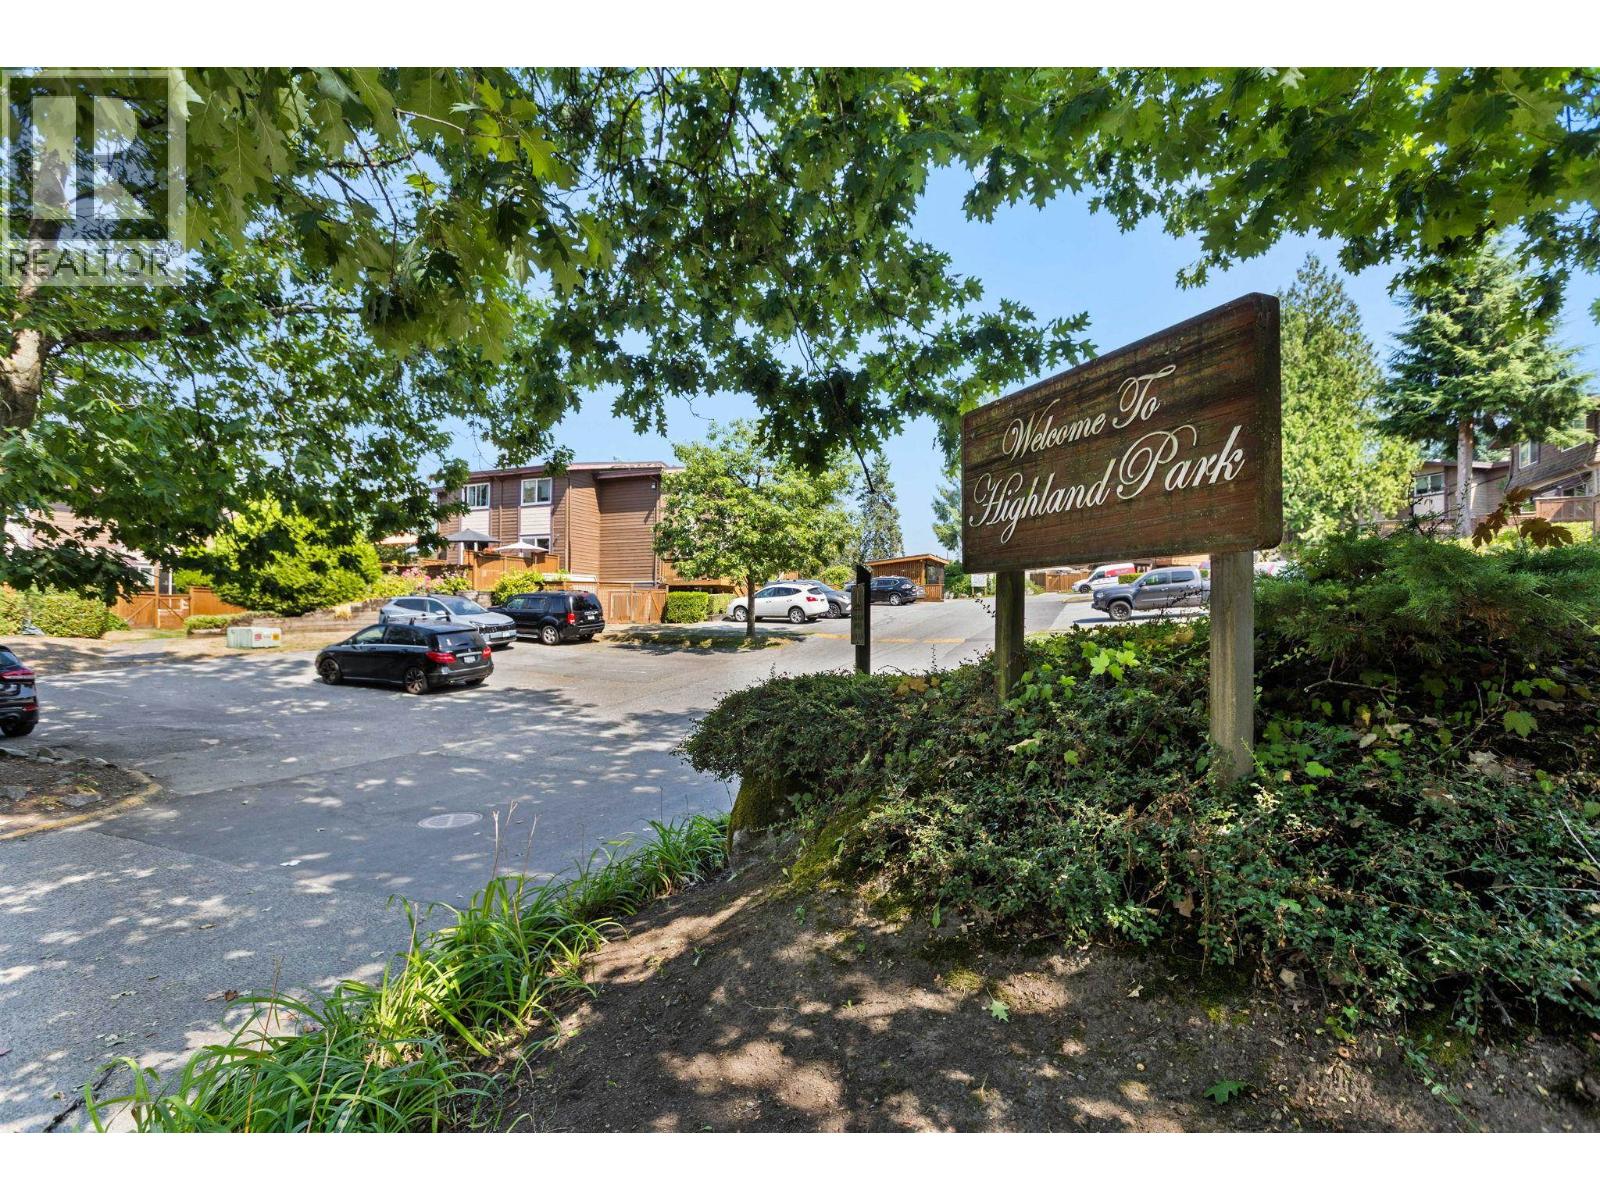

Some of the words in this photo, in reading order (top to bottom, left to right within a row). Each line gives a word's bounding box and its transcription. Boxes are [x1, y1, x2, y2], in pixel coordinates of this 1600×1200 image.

[1002, 399, 1106, 461] Welcome
[1112, 364, 1176, 429] To
[968, 457, 1116, 544] Highland
[1117, 424, 1245, 500] Park
